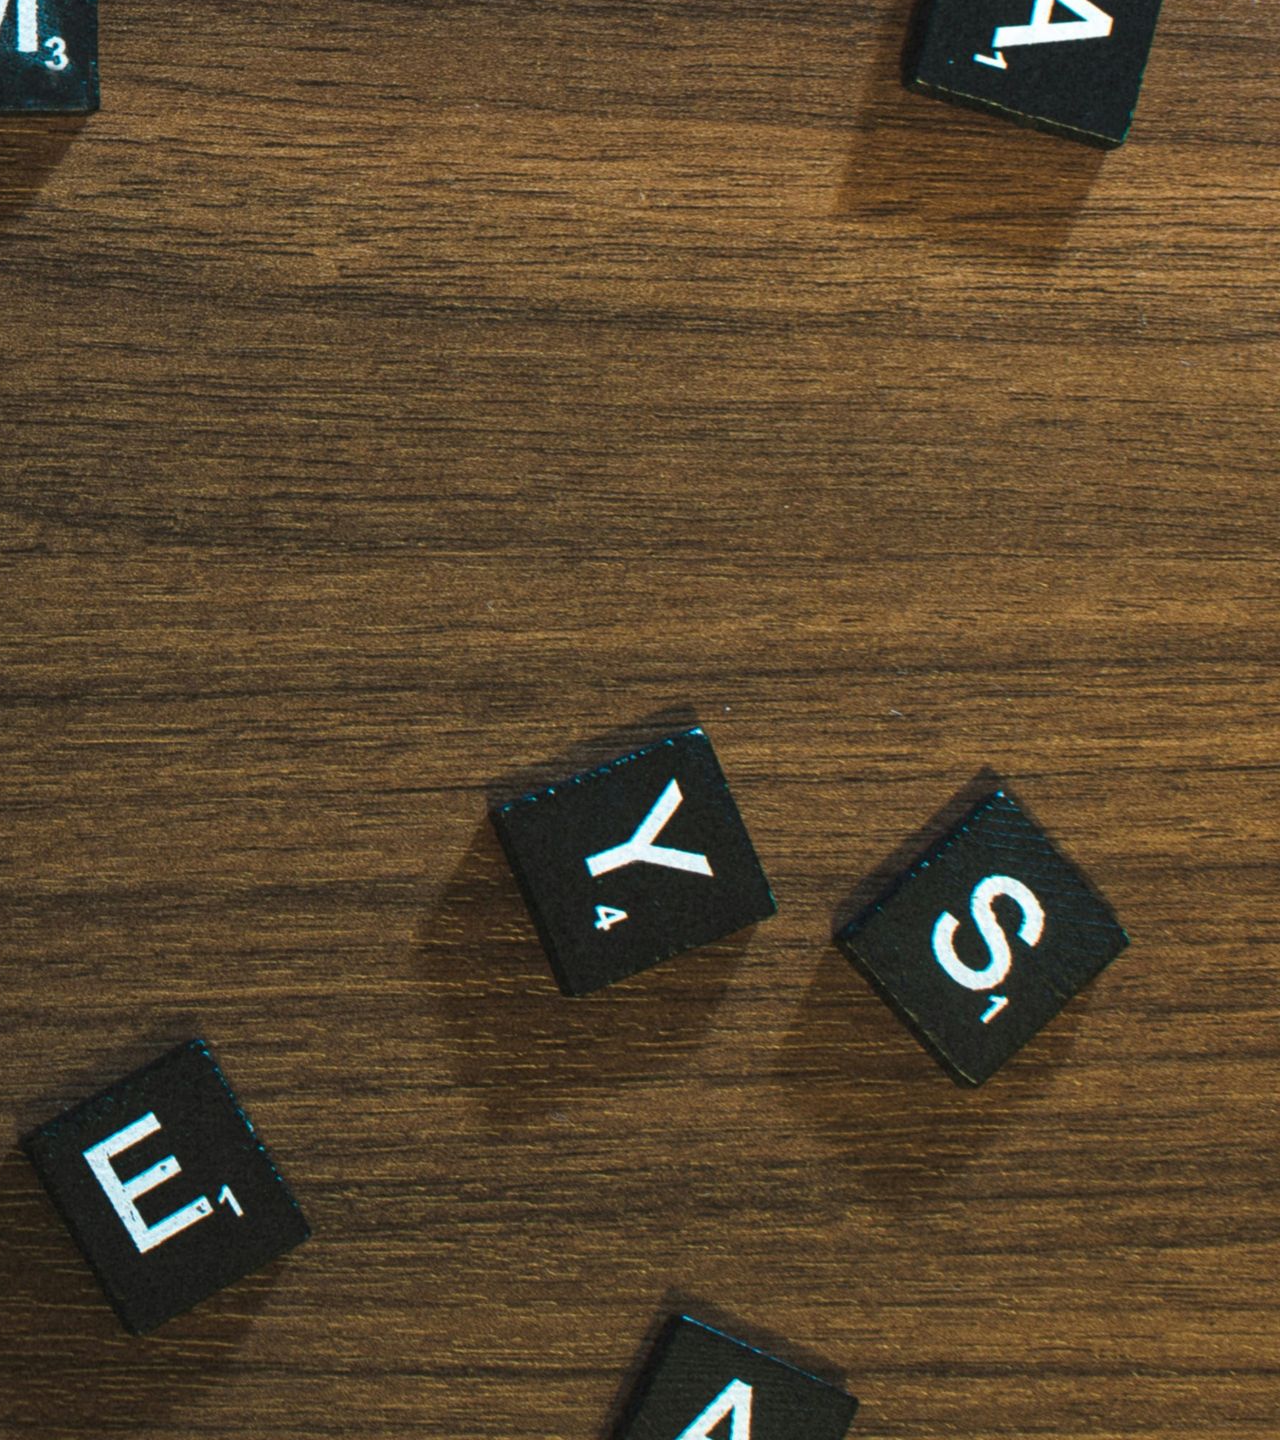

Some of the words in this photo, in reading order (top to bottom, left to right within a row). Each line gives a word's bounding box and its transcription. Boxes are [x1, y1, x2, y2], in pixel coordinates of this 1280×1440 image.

[45, 36, 69, 70] 3
[976, 49, 1009, 70] 1
[586, 779, 713, 877] Y
[597, 907, 627, 931] 4
[933, 876, 1045, 991] S
[981, 996, 1009, 1024] 1
[83, 1112, 213, 1253] E
[219, 1186, 243, 1216] 1
